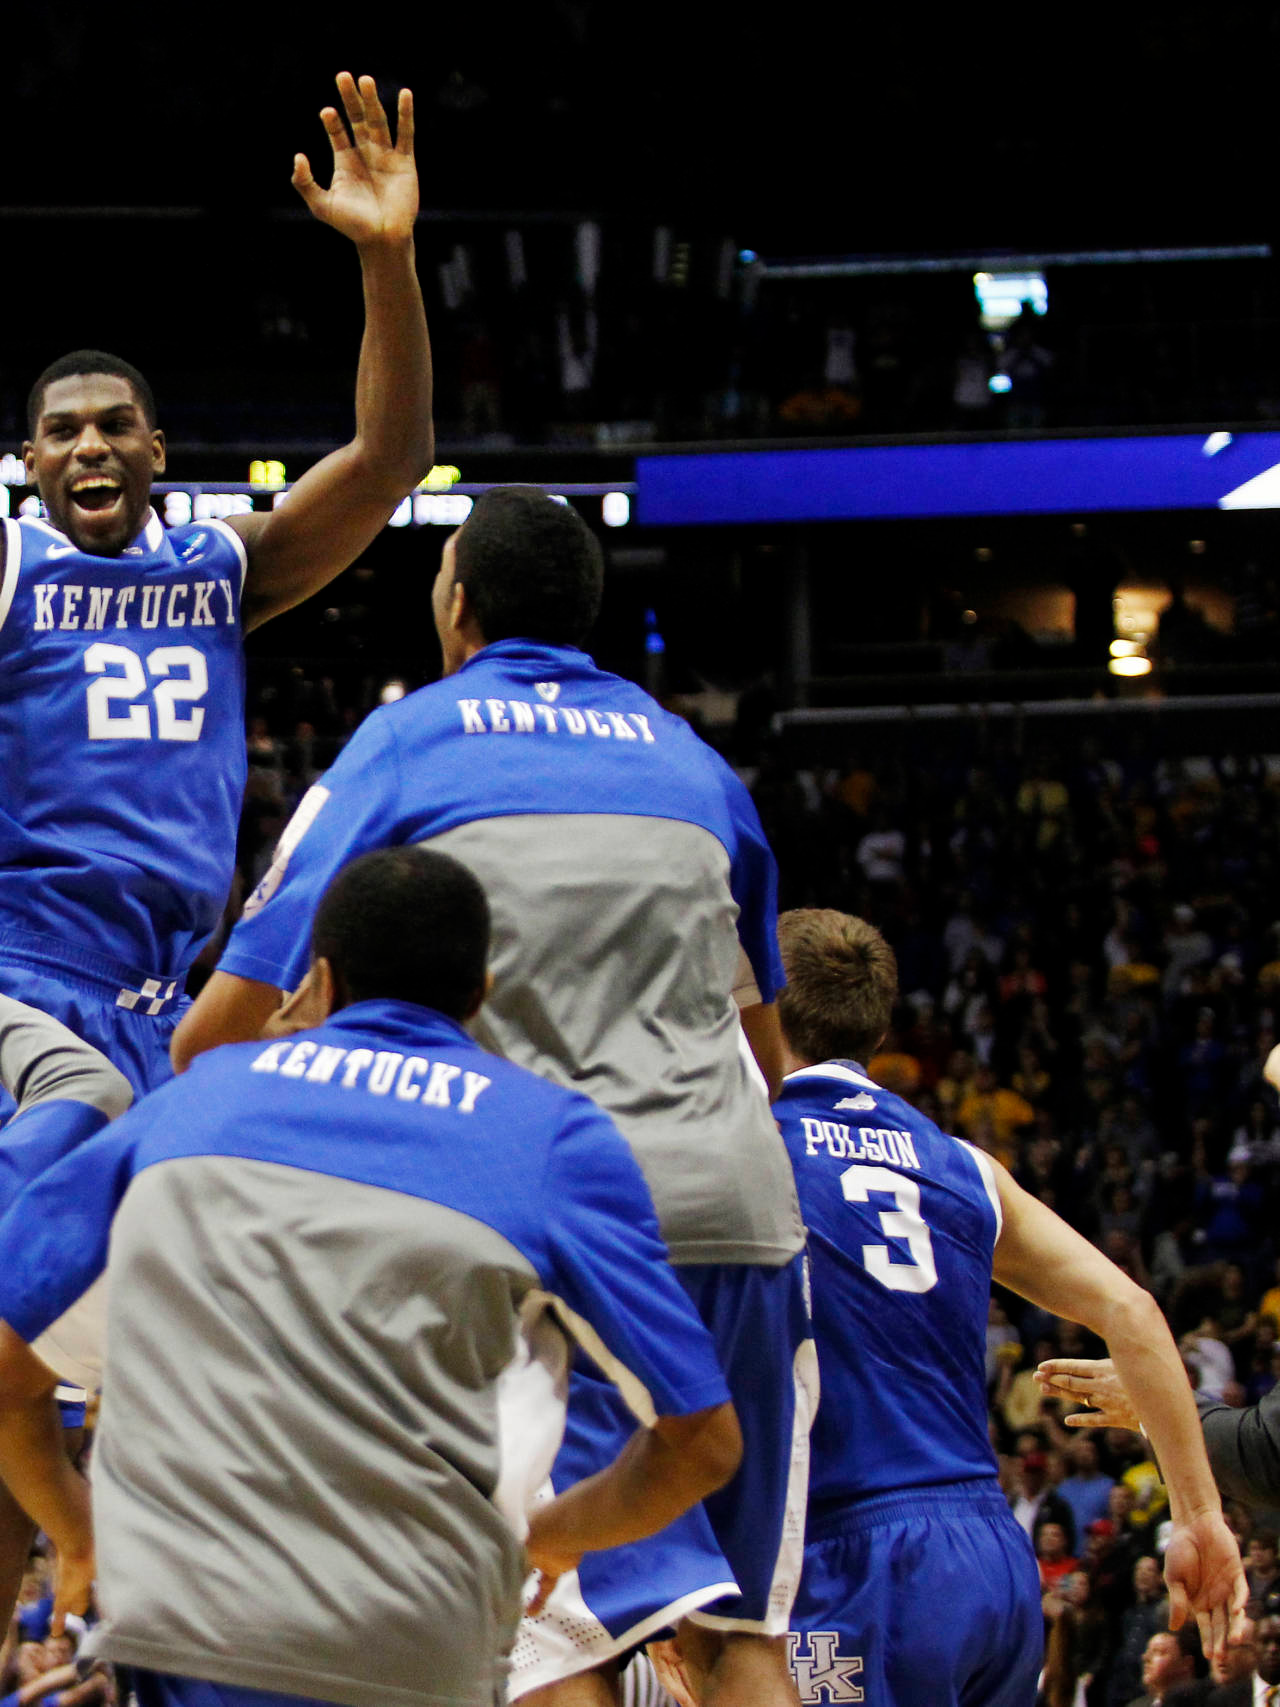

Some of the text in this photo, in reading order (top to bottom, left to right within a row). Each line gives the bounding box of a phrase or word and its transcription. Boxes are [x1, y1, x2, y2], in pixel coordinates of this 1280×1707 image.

[33, 579, 236, 631] KENTUCKY
[83, 642, 209, 742] 22
[457, 699, 656, 744] KENTUCKY
[250, 1040, 492, 1113] KENTUCKY
[800, 1117, 921, 1168] POLSON
[840, 1165, 938, 1293] 3
